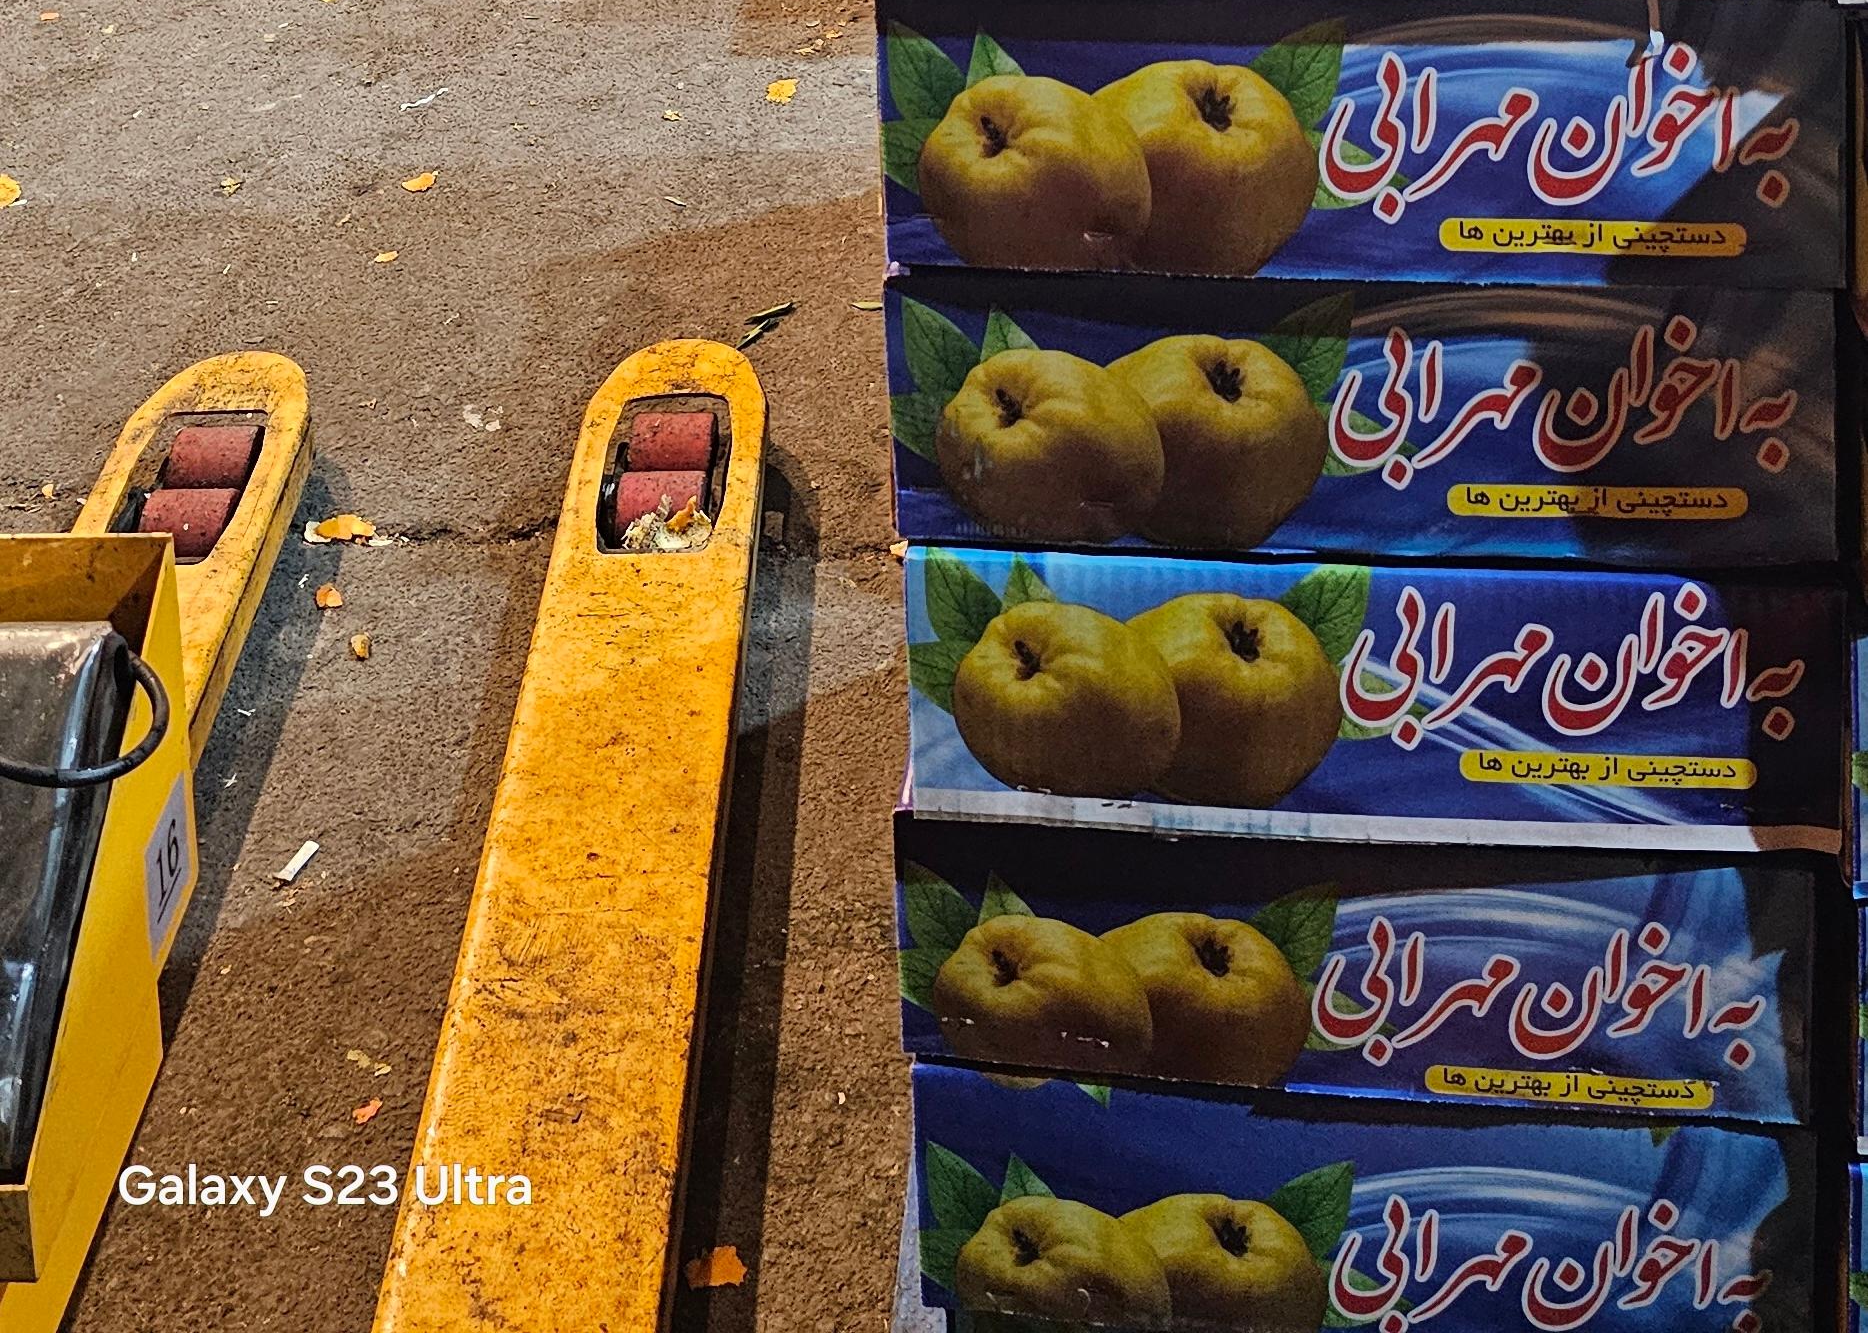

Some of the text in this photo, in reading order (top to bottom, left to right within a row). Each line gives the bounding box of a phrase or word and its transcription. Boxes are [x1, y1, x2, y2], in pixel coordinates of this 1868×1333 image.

[1318, 43, 1799, 225] به اخوان مهرابی
[1459, 220, 1727, 253] دستچینی از بهترین ها
[1328, 318, 1799, 491] به اخوان مهرابی
[1465, 486, 1729, 517] دستچینی از بهترین ها
[1340, 579, 1806, 752] به اخوان مهرابی
[1478, 751, 1737, 786] دستچینی از بهترین ها
[154, 818, 182, 903] 16
[1310, 915, 1767, 1069] به اخوان مهرابی
[1443, 1067, 1696, 1106] دستچینی از بهترین ها
[1327, 1191, 1533, 1333] مهرابی
[1520, 1198, 1719, 1332] اخوان
